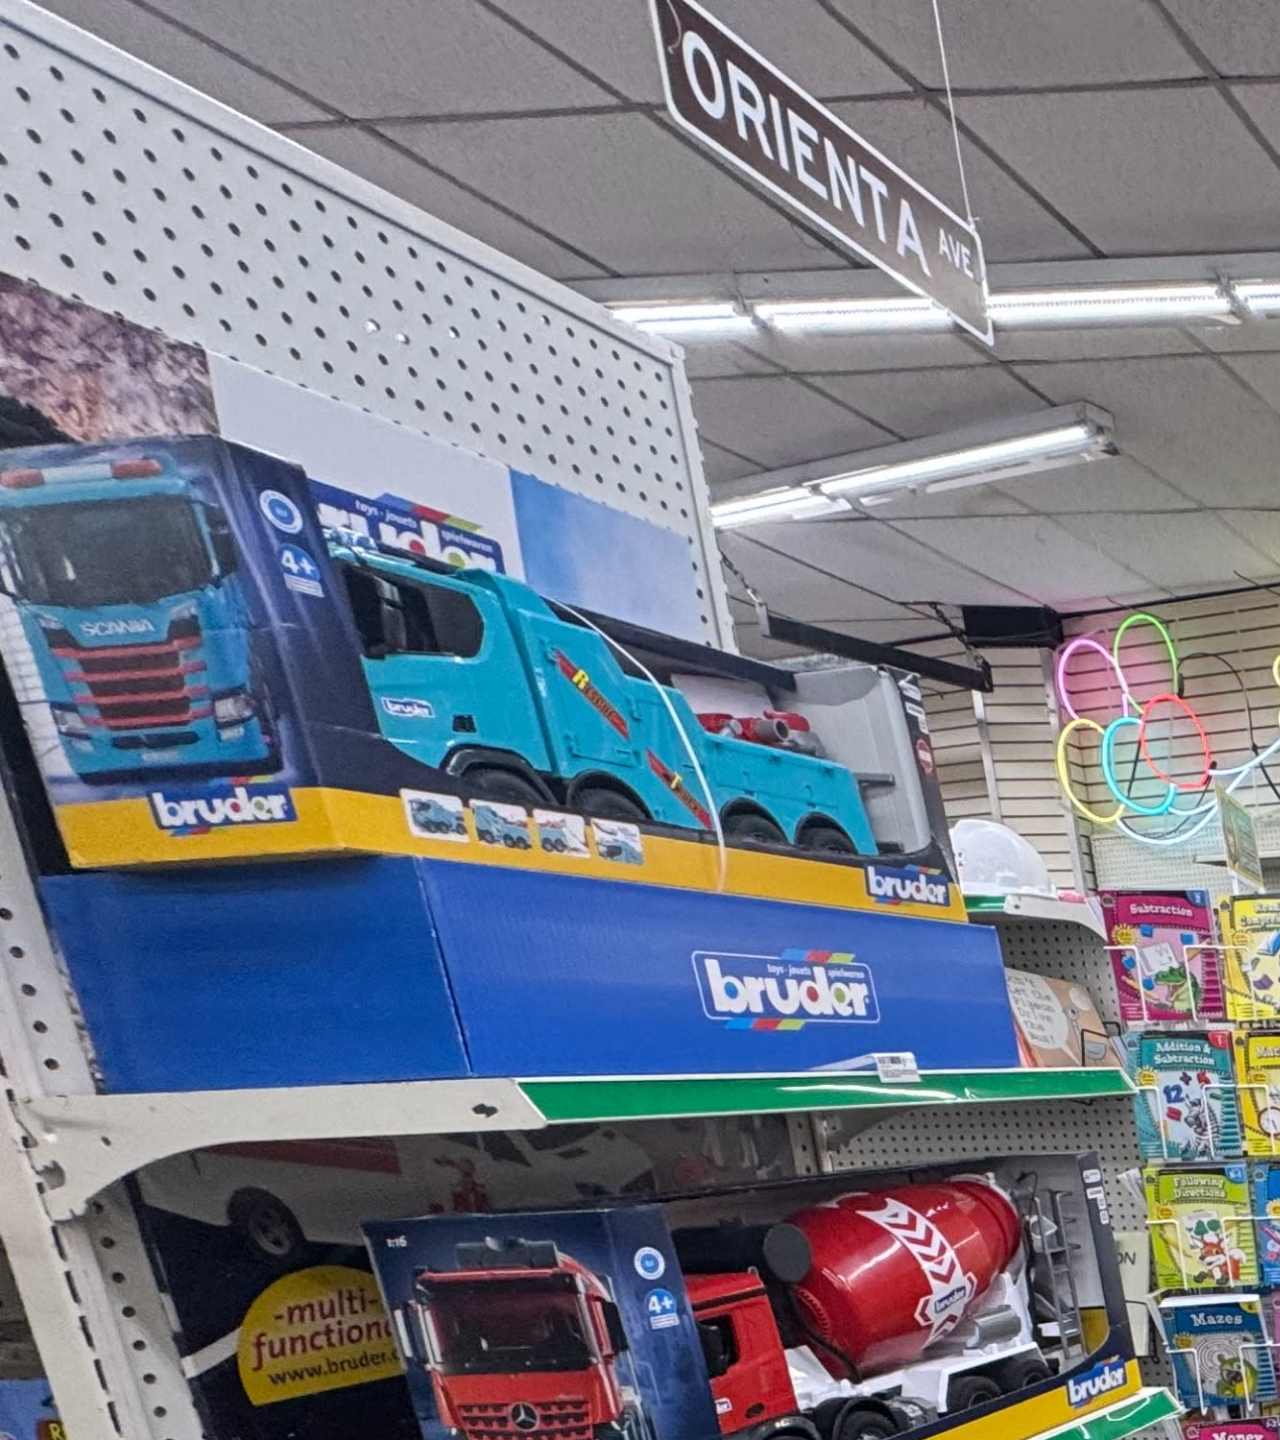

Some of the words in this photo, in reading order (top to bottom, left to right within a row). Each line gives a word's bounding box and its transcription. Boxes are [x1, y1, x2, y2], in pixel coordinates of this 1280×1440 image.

[683, 30, 932, 278] ORIENTA
[937, 228, 974, 279] AVE
[151, 786, 288, 828] bruder
[867, 866, 948, 904] bruder
[1129, 903, 1193, 917] Subtraction
[703, 957, 870, 1017] bruder
[1156, 1042, 1201, 1053] Addition
[1154, 1054, 1215, 1066] Subtraction
[1174, 1177, 1225, 1189] Following
[647, 1296, 676, 1317] 4+
[1190, 1311, 1244, 1327] Mazes
[1068, 1361, 1127, 1402] bruder
